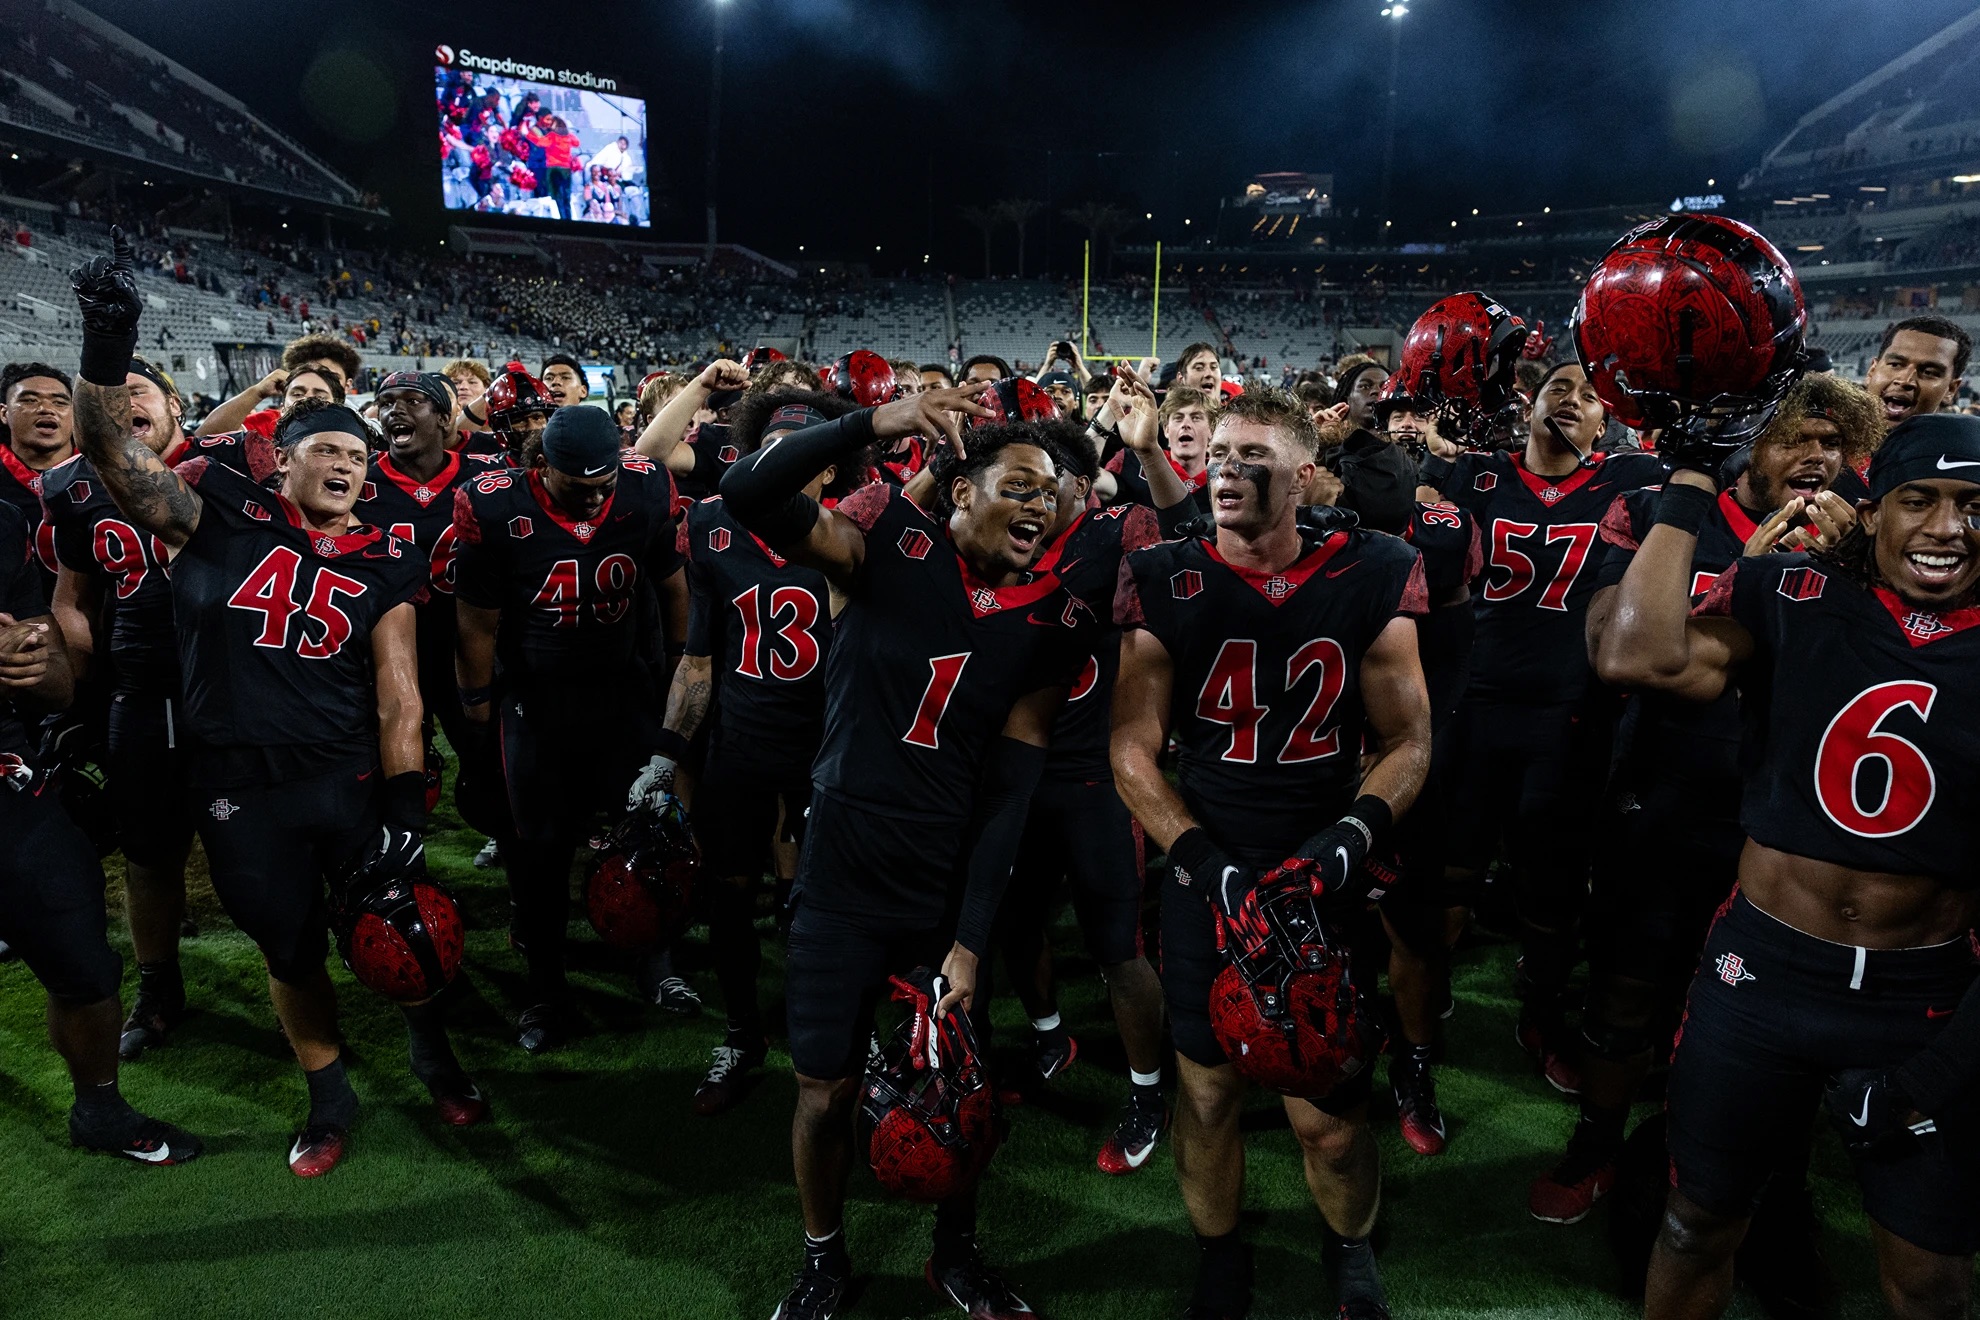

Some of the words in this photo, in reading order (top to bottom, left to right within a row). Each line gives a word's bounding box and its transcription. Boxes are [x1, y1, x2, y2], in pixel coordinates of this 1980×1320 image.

[458, 49, 556, 82] Snapdragon
[557, 66, 617, 92] stadium
[93, 518, 172, 600] 9
[227, 545, 369, 660] 45
[1482, 517, 1599, 613] 57
[732, 583, 821, 682] 13
[901, 651, 973, 751] 1
[1195, 636, 1348, 765] 42
[1814, 679, 1939, 839] 6
